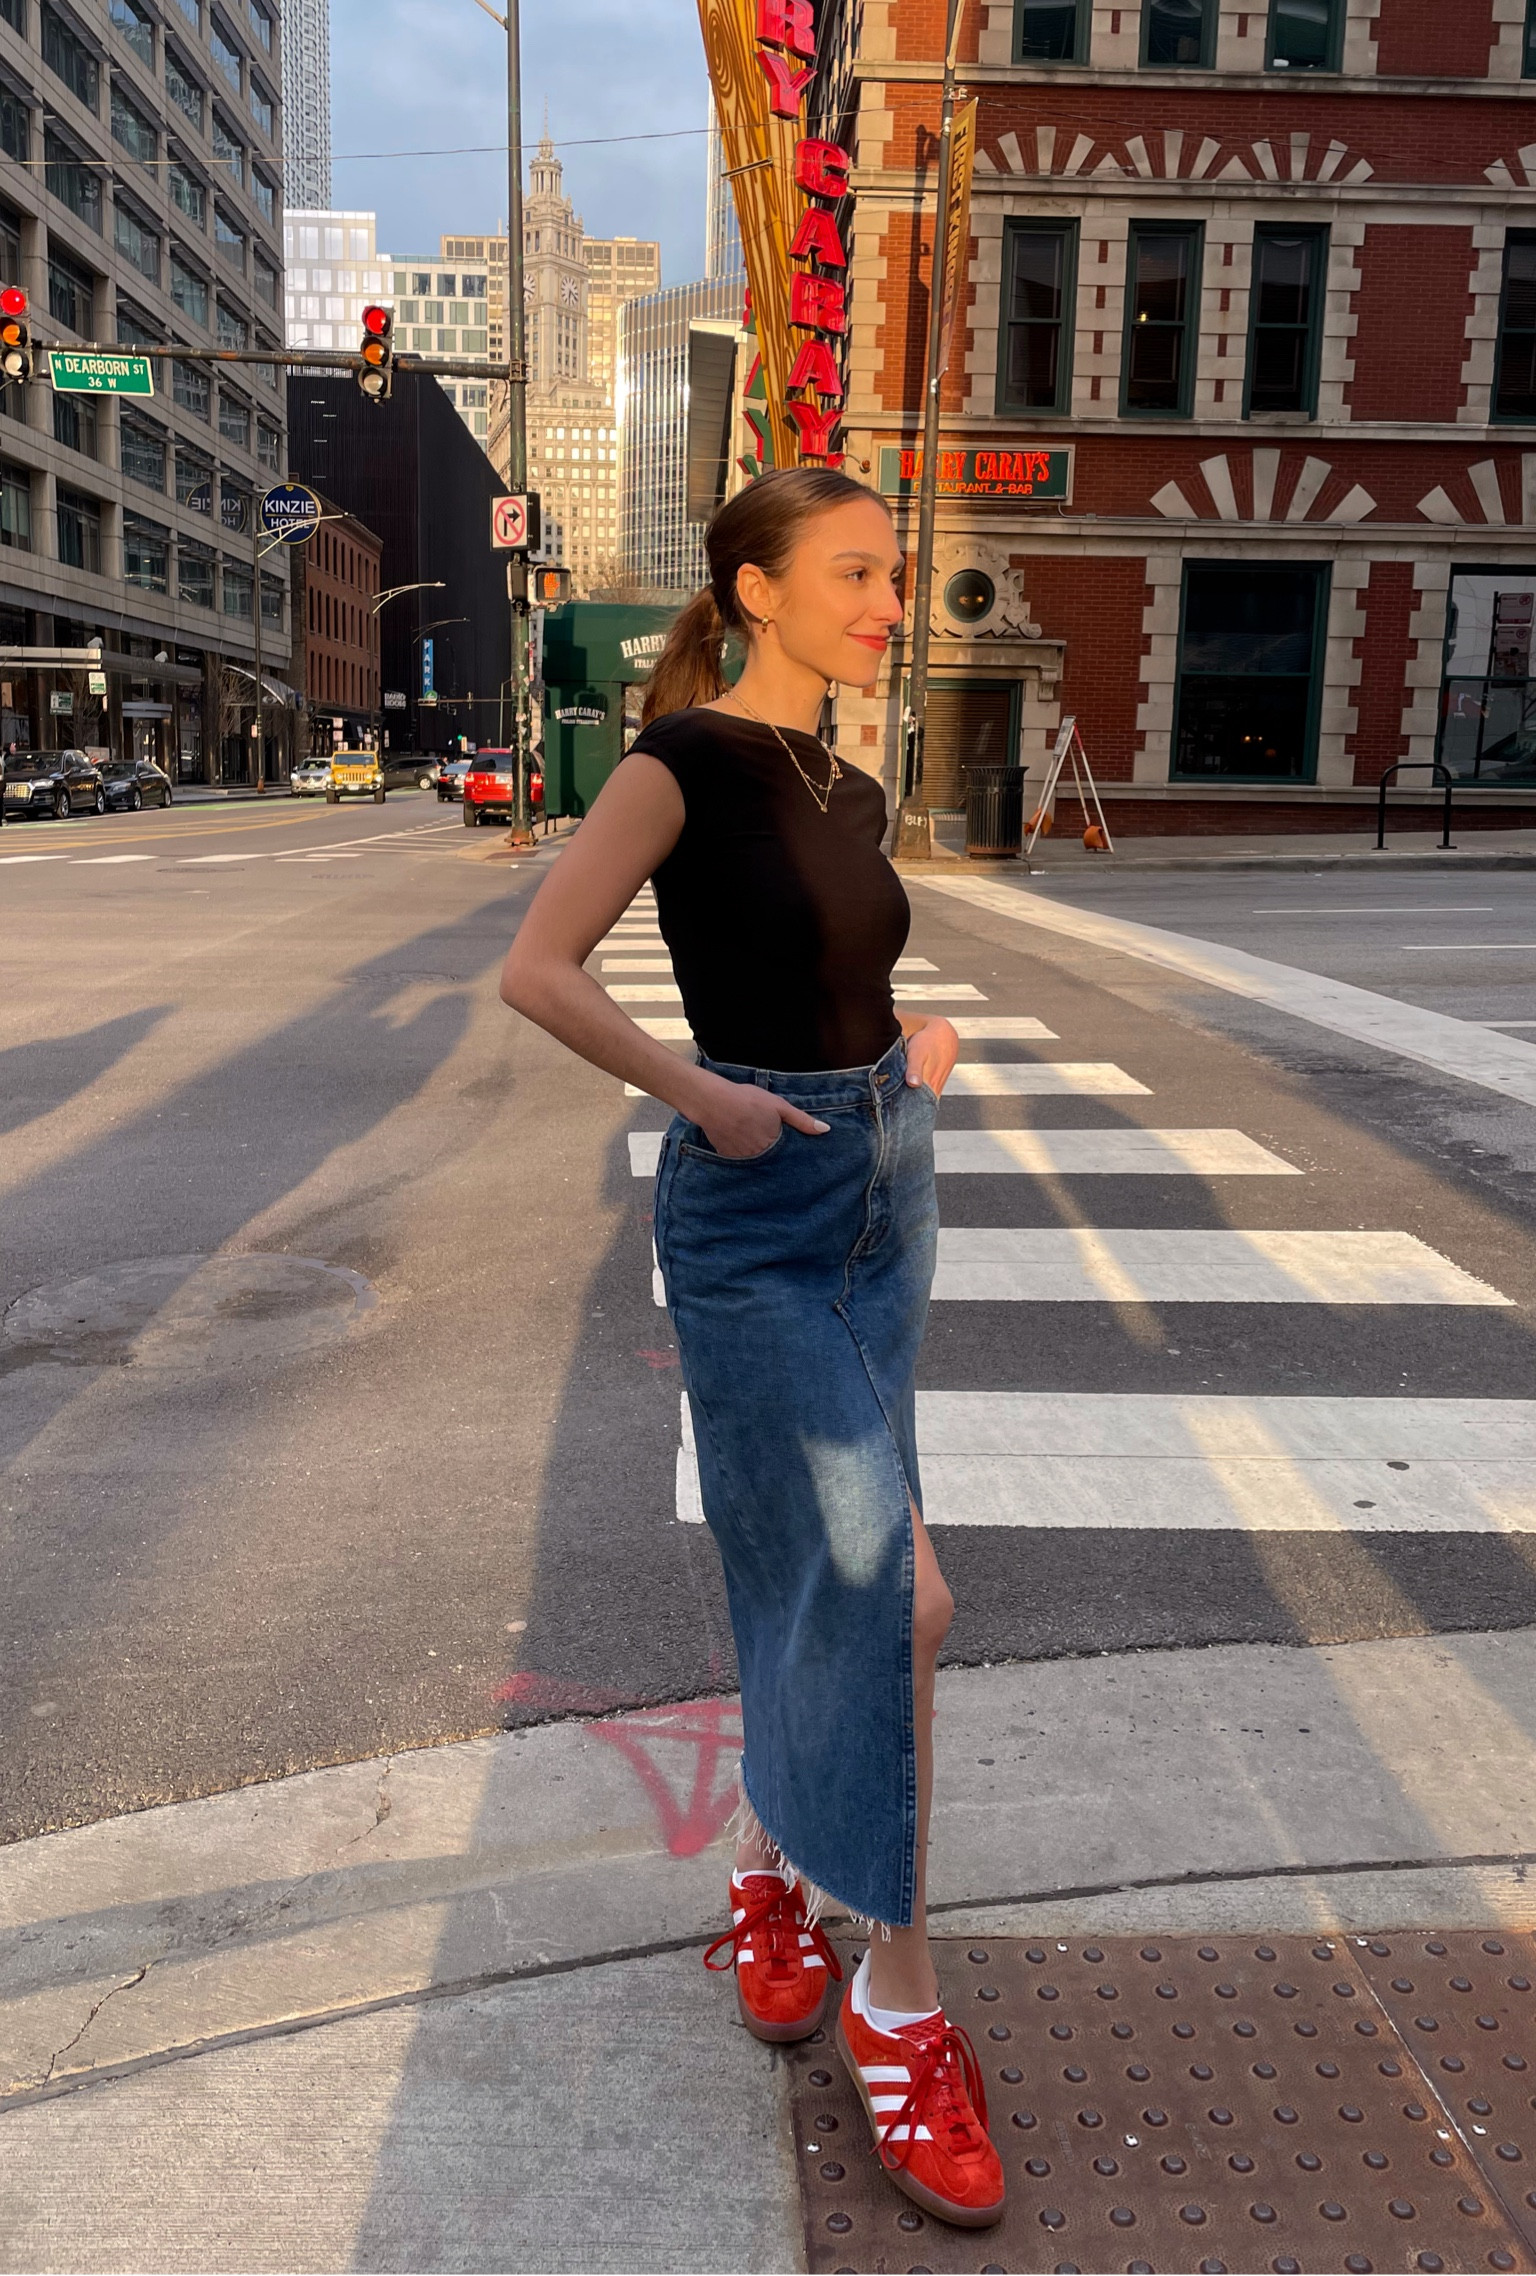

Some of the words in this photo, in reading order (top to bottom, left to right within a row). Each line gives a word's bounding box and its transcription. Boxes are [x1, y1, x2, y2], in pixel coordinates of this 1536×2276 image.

[952, 117, 969, 203] FIRST
[785, 137, 848, 468] CARAY'
[55, 359, 62, 371] N
[64, 357, 130, 376] DEARBORN
[133, 364, 144, 375] ST
[88, 376, 102, 387] 36
[107, 378, 117, 388] W
[899, 450, 967, 480] HARY
[975, 450, 1050, 482] CARAY'S
[913, 481, 991, 494] RTAURANT
[1008, 483, 1033, 495] BAR
[264, 500, 316, 514] KINZIE
[620, 634, 667, 658] HARRY
[423, 641, 431, 687] PARK
[554, 706, 577, 720] HARRY
[578, 706, 605, 721] CARAY'S
